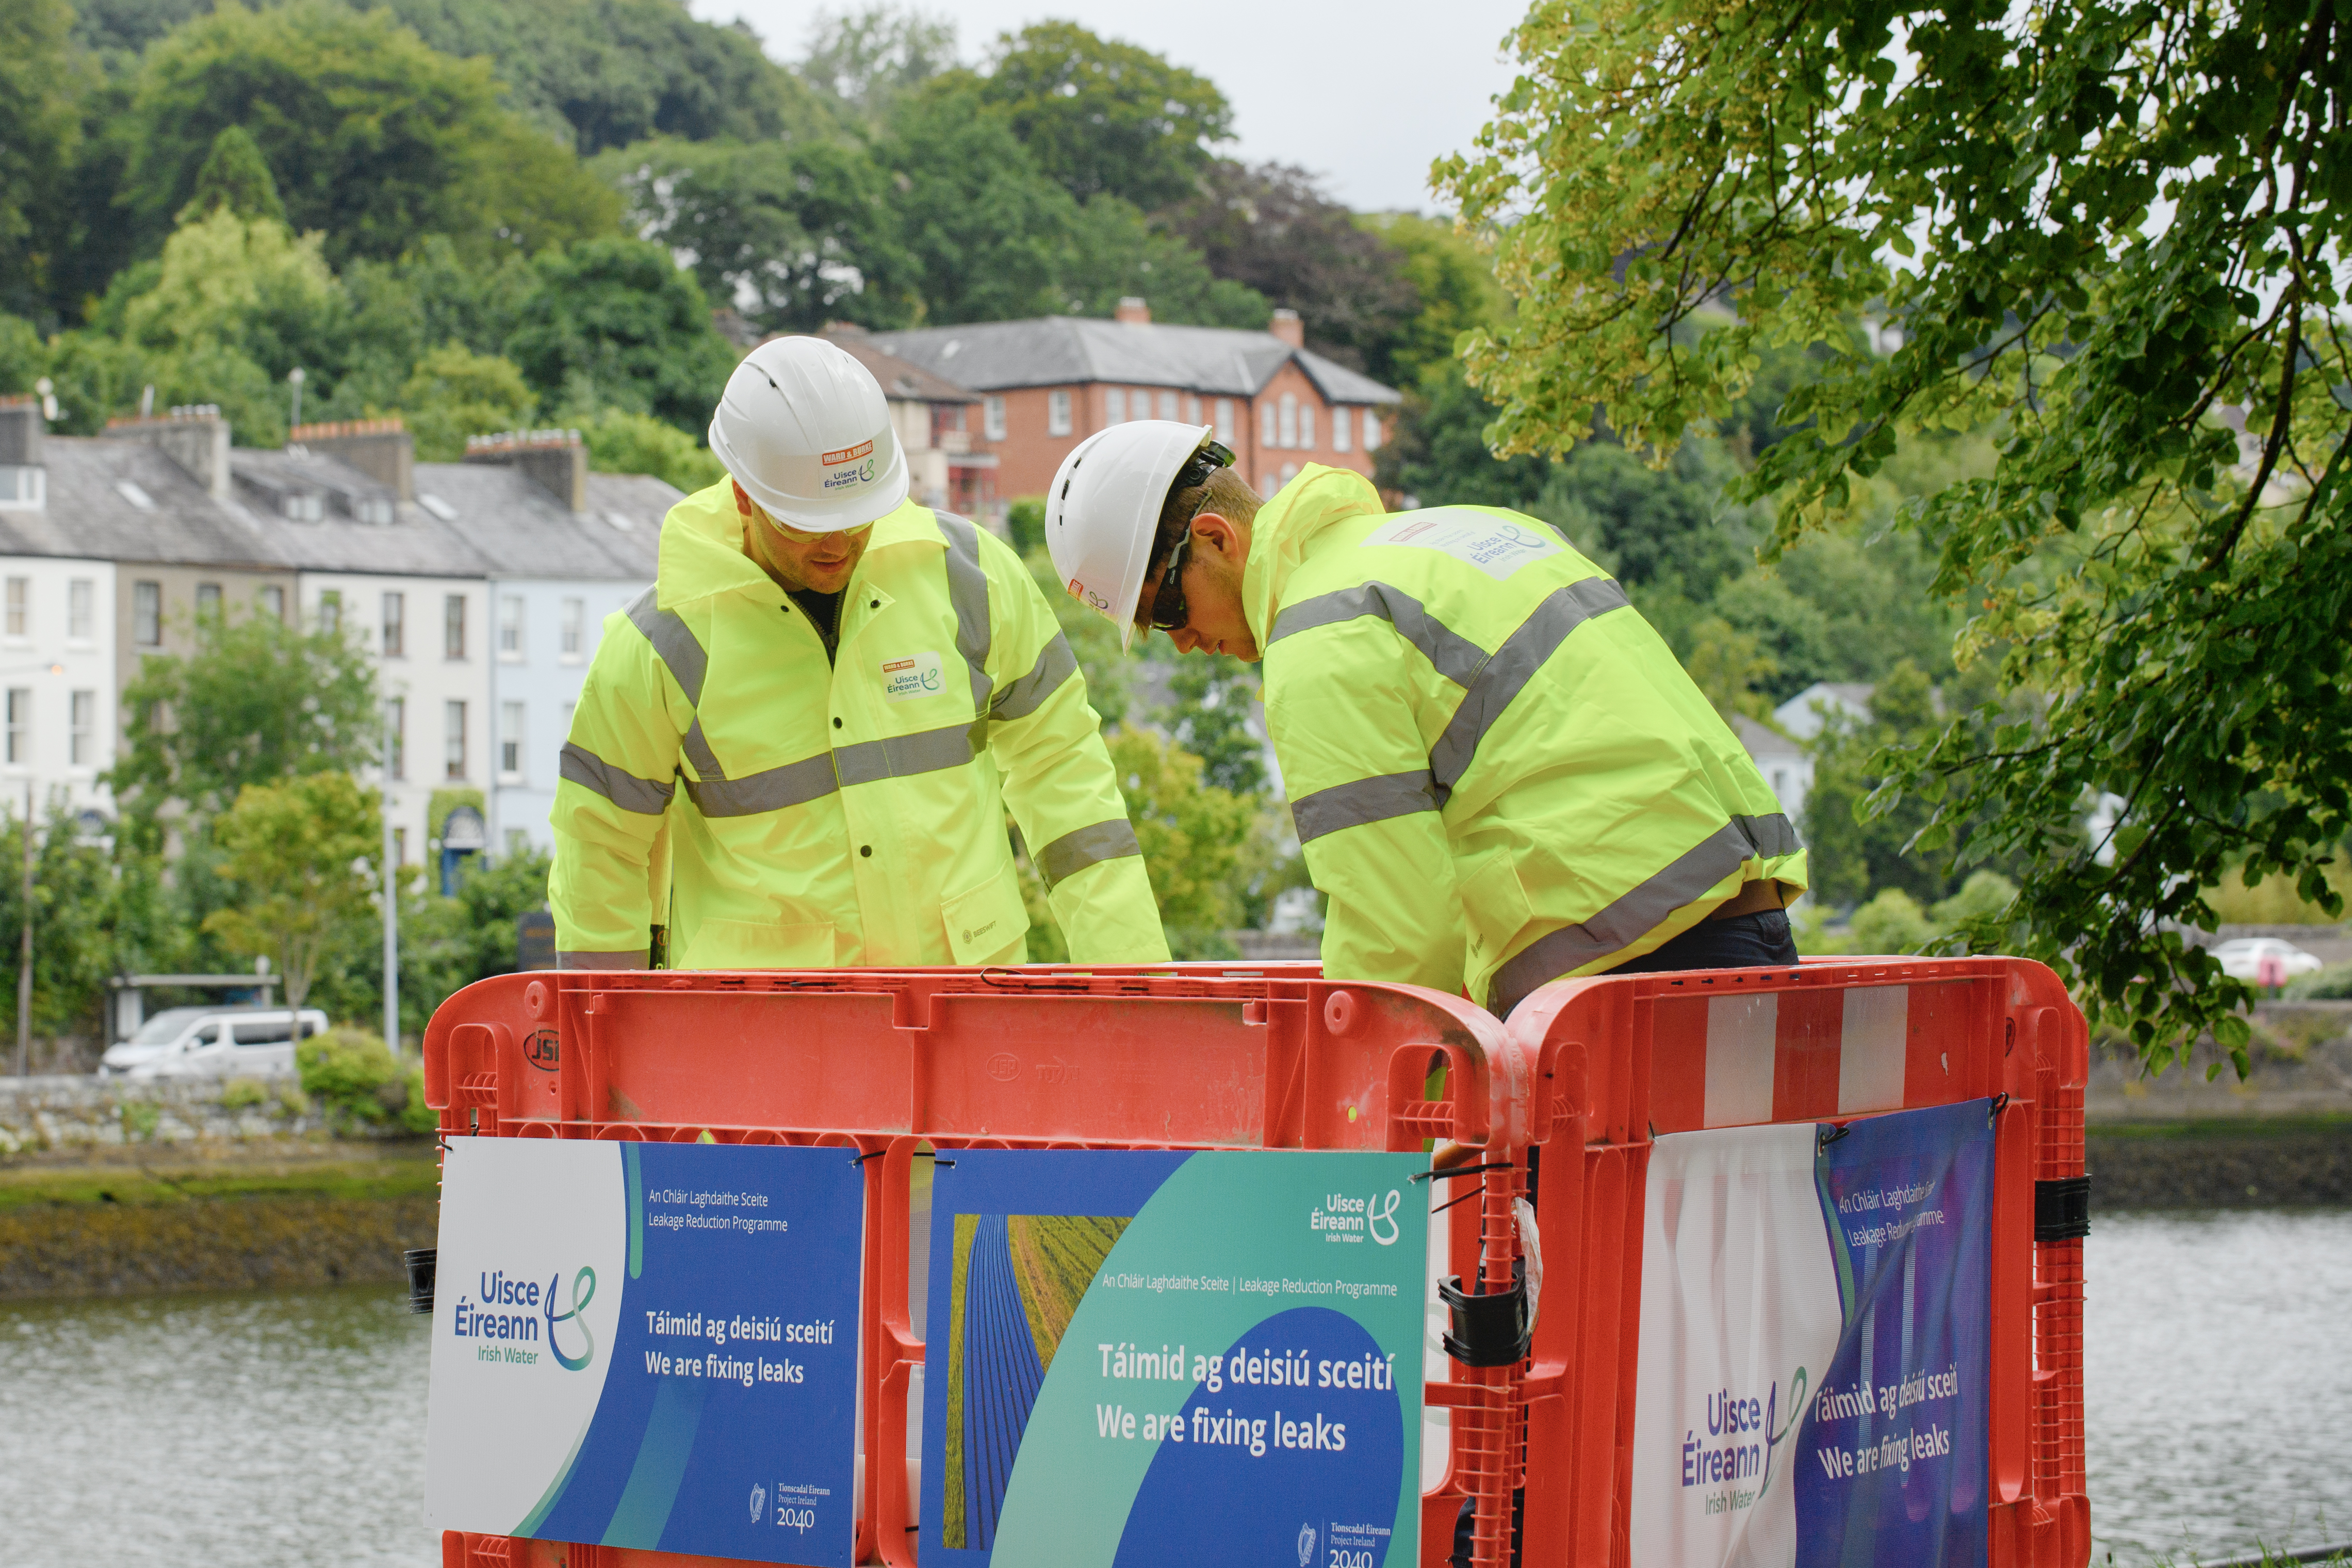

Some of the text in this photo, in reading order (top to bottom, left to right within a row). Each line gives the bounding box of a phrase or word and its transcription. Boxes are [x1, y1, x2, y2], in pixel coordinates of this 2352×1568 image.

[824, 452, 845, 462] WARD
[853, 442, 872, 456] BURKE
[824, 476, 857, 487] Éireann
[834, 470, 856, 479] Uisce
[1466, 537, 1502, 550] Uisce
[1469, 543, 1517, 564] Éireann
[887, 682, 920, 693] Éireann
[895, 675, 918, 684] Uisce
[973, 920, 996, 937] BEESWIFT
[991, 1059, 1017, 1075] JSP
[649, 1189, 768, 1208] An Chláir Laghdaithe Sceite
[1327, 1193, 1365, 1212] Uisce
[1839, 1196, 1852, 1214] An
[1852, 1189, 1880, 1212] Chláir
[649, 1212, 788, 1234] Leakage Reduction Programme
[1311, 1207, 1364, 1231] Éireann
[1326, 1232, 1364, 1243] Irish Water
[1848, 1226, 1887, 1248] Leakage
[481, 1270, 540, 1306] Uisce
[1102, 1273, 1397, 1299] An Chláir Laghdaithe Sceite Leakage Reduction Programme
[455, 1296, 538, 1341] Éireann
[646, 1311, 835, 1345] Táimid ag deisiú sceití
[478, 1345, 538, 1364] Irish Water
[645, 1351, 804, 1387] We are fixing leaks
[1098, 1343, 1396, 1392] Táimid ag deisiú sceití
[1816, 1381, 1876, 1423] Táimid
[1880, 1385, 1897, 1419] ag
[1899, 1369, 1925, 1408] deisiú
[1708, 1388, 1760, 1436] Uisce
[1096, 1404, 1346, 1457] We are fixing leaks
[1682, 1430, 1759, 1487] Éireann
[1818, 1424, 1949, 1479] We are fixing leaks
[778, 1482, 830, 1495] Tionscadal Éireann
[778, 1494, 816, 1506] Project Ireland
[1706, 1490, 1755, 1515] Irish Water
[777, 1507, 814, 1535] 2040
[1331, 1522, 1391, 1536] Tionscadal Éireann
[1331, 1534, 1375, 1547] Project Ireland
[1329, 1549, 1373, 1568] 2040
